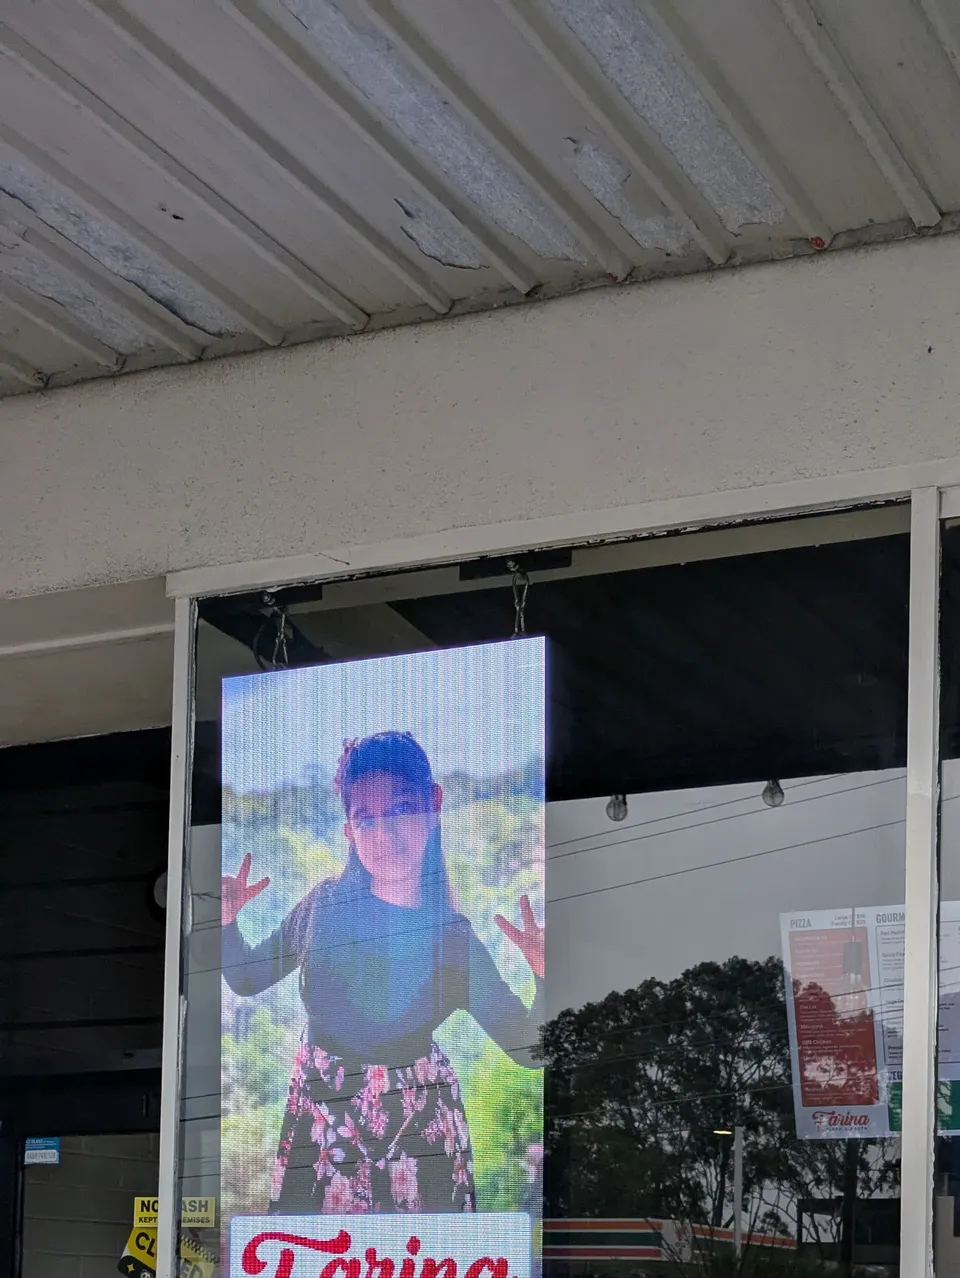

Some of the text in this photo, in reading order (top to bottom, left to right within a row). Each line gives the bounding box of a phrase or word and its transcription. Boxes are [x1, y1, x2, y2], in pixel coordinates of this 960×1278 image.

[876, 912, 905, 923] GOURM
[790, 918, 811, 928] PIZZA
[181, 1200, 209, 1213] ASH
[182, 1216, 210, 1224] EMISES
